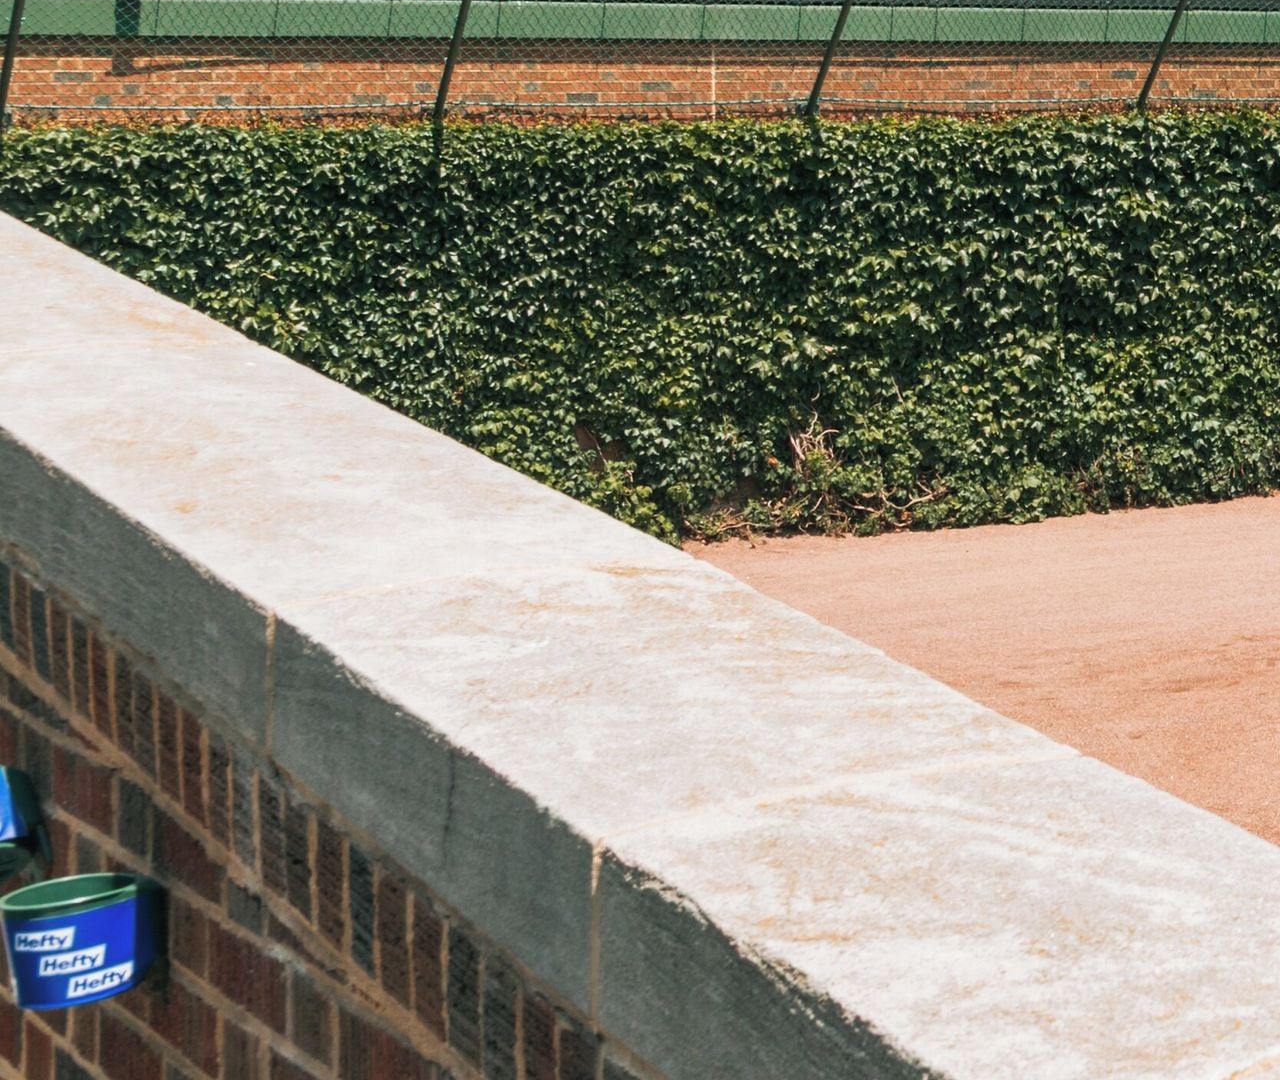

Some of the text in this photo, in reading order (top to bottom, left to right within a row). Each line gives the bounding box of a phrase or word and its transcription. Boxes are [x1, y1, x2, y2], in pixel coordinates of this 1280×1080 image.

[17, 934, 68, 948] Hefty
[43, 953, 100, 972] Hefty
[73, 969, 127, 993] Hefty
